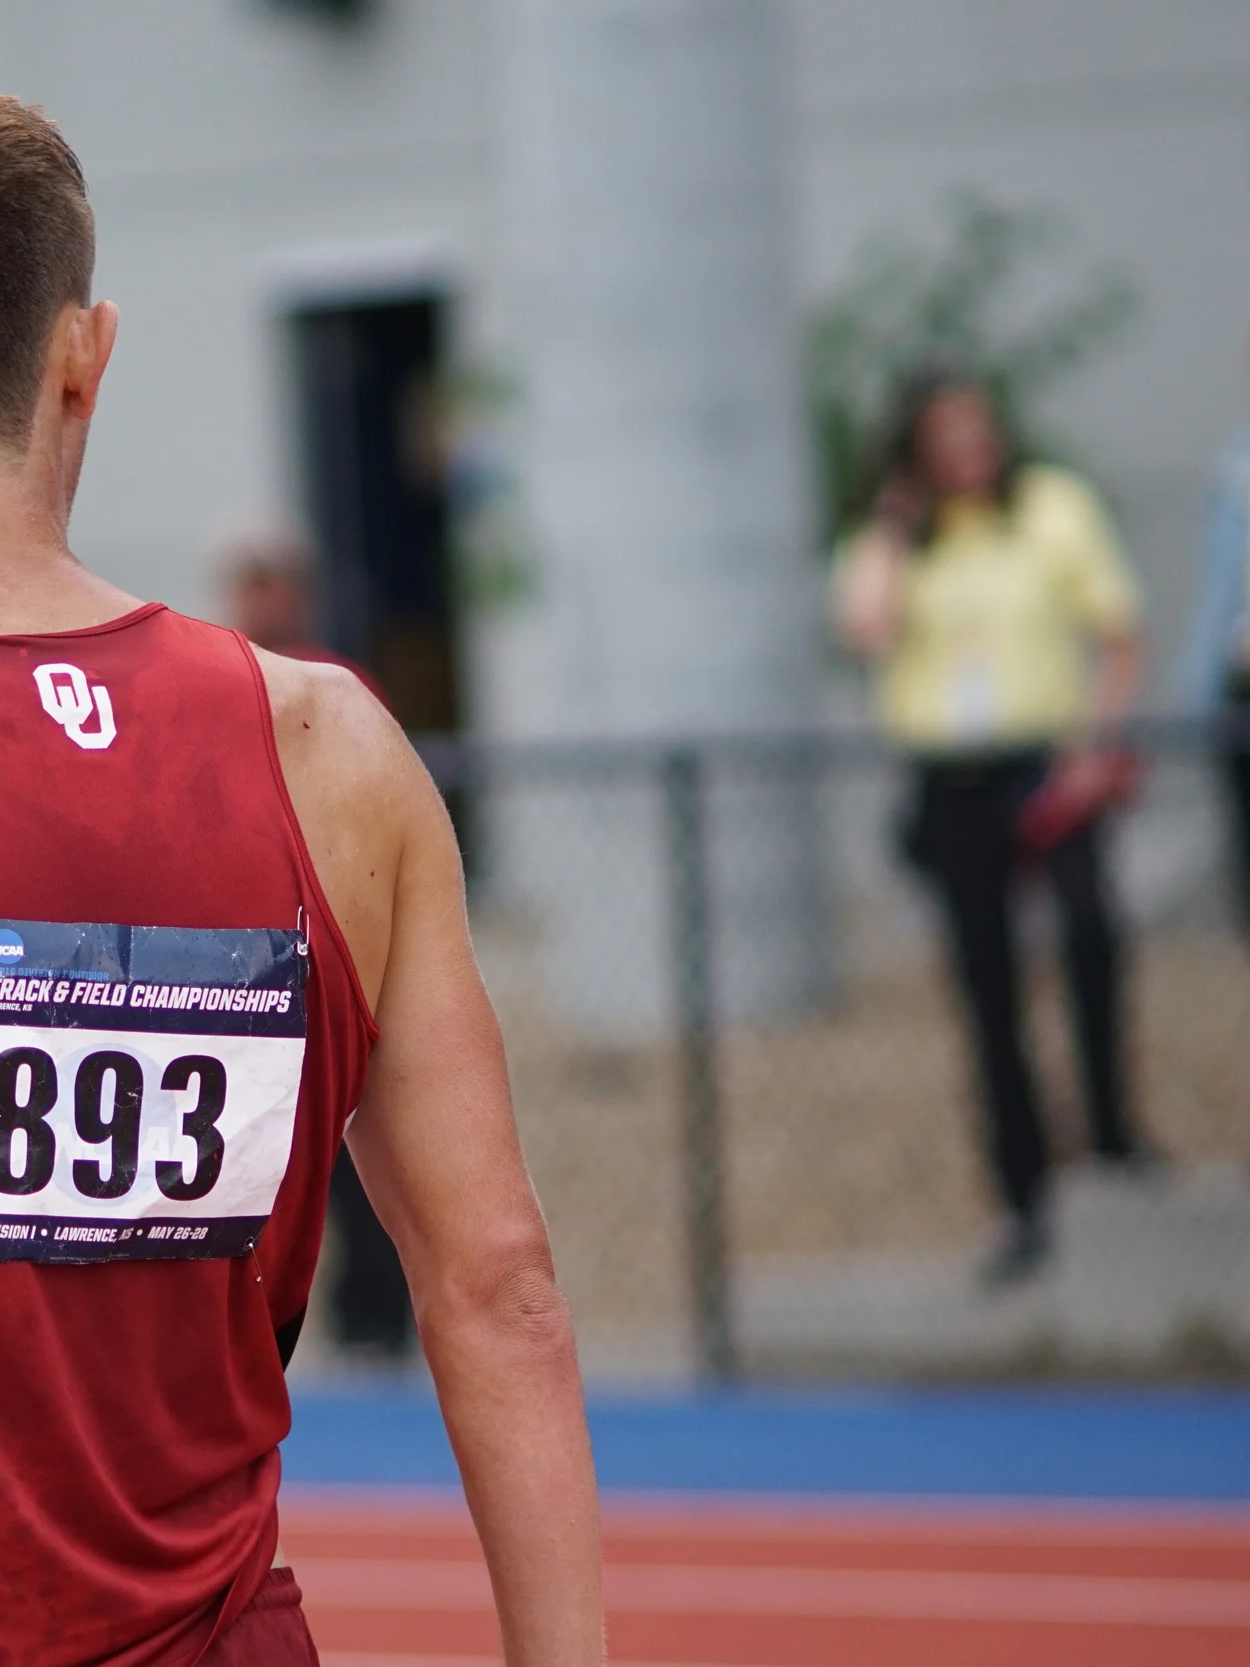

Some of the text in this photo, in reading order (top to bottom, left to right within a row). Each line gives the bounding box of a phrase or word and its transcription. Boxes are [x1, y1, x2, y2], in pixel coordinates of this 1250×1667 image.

[32, 662, 117, 749] OU
[18, 967, 61, 979] DIVISION
[62, 969, 68, 979] I
[69, 970, 110, 981] OUTDOOR
[53, 981, 70, 1003] &
[70, 982, 127, 1007] FIELD
[129, 984, 293, 1013] CHAMPIONSHIPS
[22, 1003, 33, 1012] KS
[30, 1225, 36, 1239] I
[53, 1226, 118, 1243] LAWRENCE,
[119, 1228, 134, 1240] KS
[147, 1226, 175, 1240] MAY
[174, 1227, 209, 1240] 26-28
